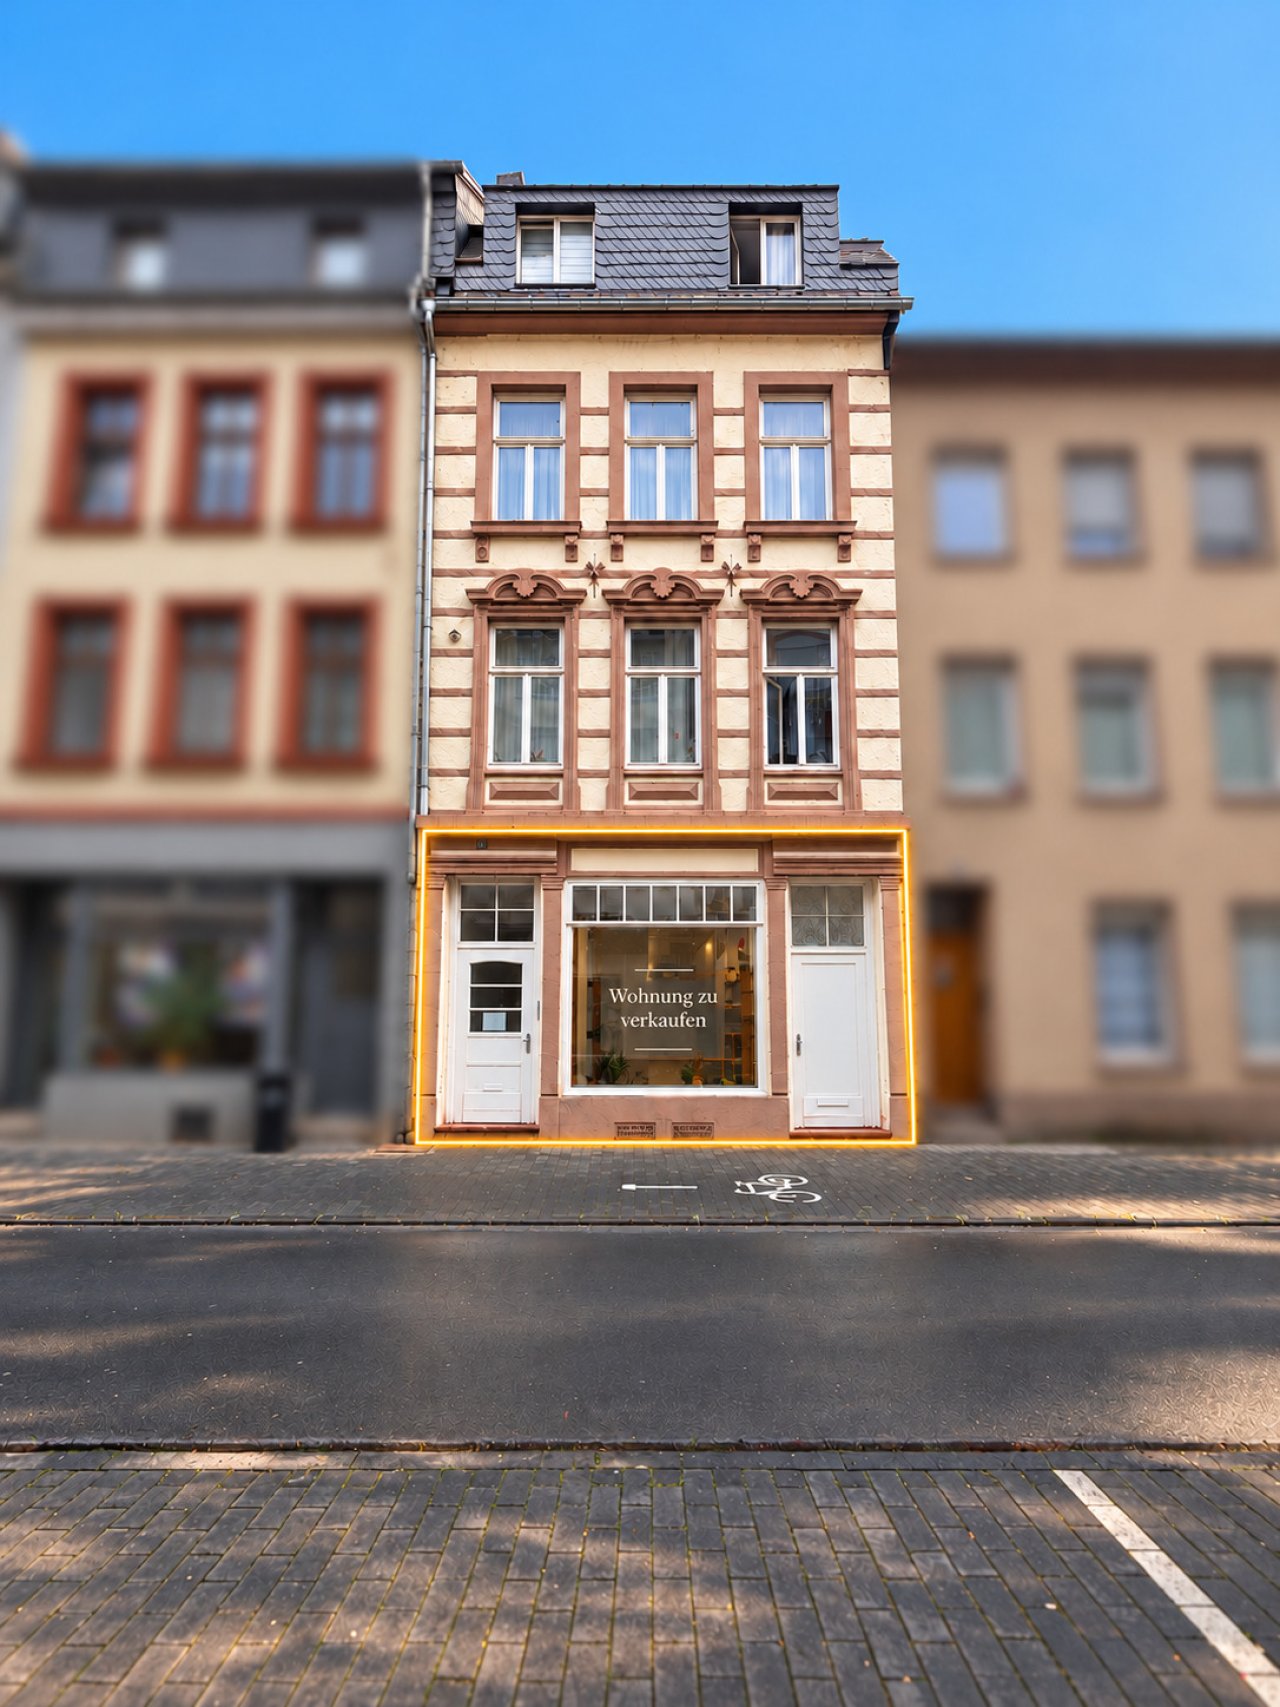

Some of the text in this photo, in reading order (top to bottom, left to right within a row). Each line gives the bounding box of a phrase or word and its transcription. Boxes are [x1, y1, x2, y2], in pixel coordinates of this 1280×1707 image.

[609, 988, 718, 1008] Wohnung zu
[620, 1011, 707, 1028] verkaufen
